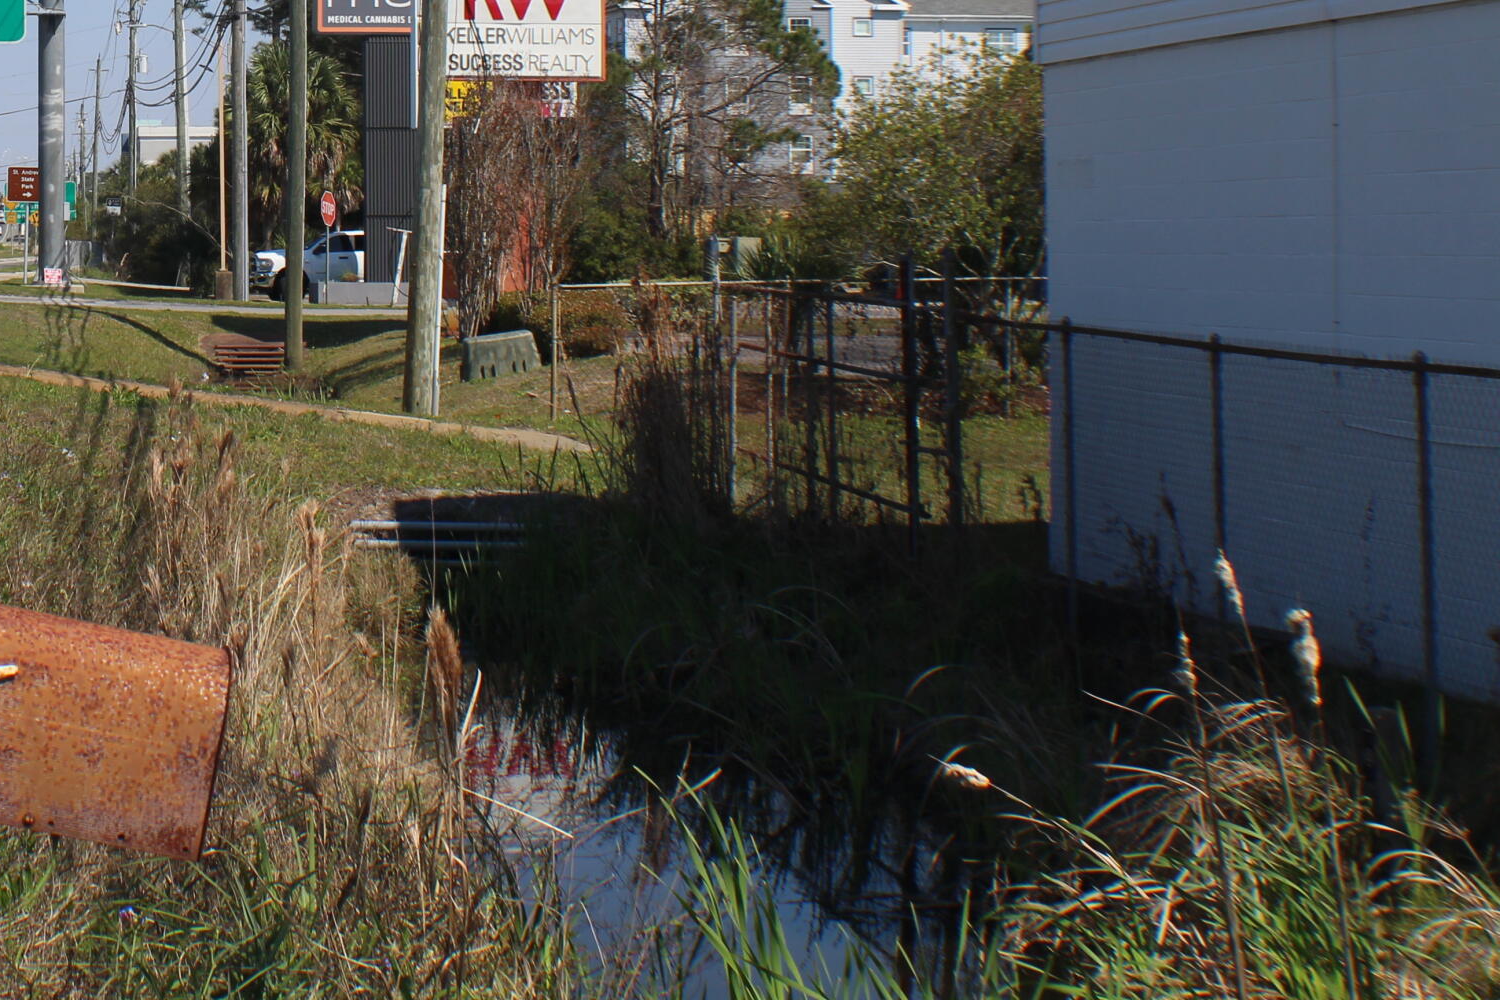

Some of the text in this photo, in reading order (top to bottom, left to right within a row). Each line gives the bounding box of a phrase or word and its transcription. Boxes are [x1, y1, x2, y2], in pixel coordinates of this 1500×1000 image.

[327, 15, 363, 24] MEDICAL
[365, 15, 405, 24] CANNABIS
[448, 53, 594, 72] SUCCESS REALTY
[322, 201, 334, 215] STOP
